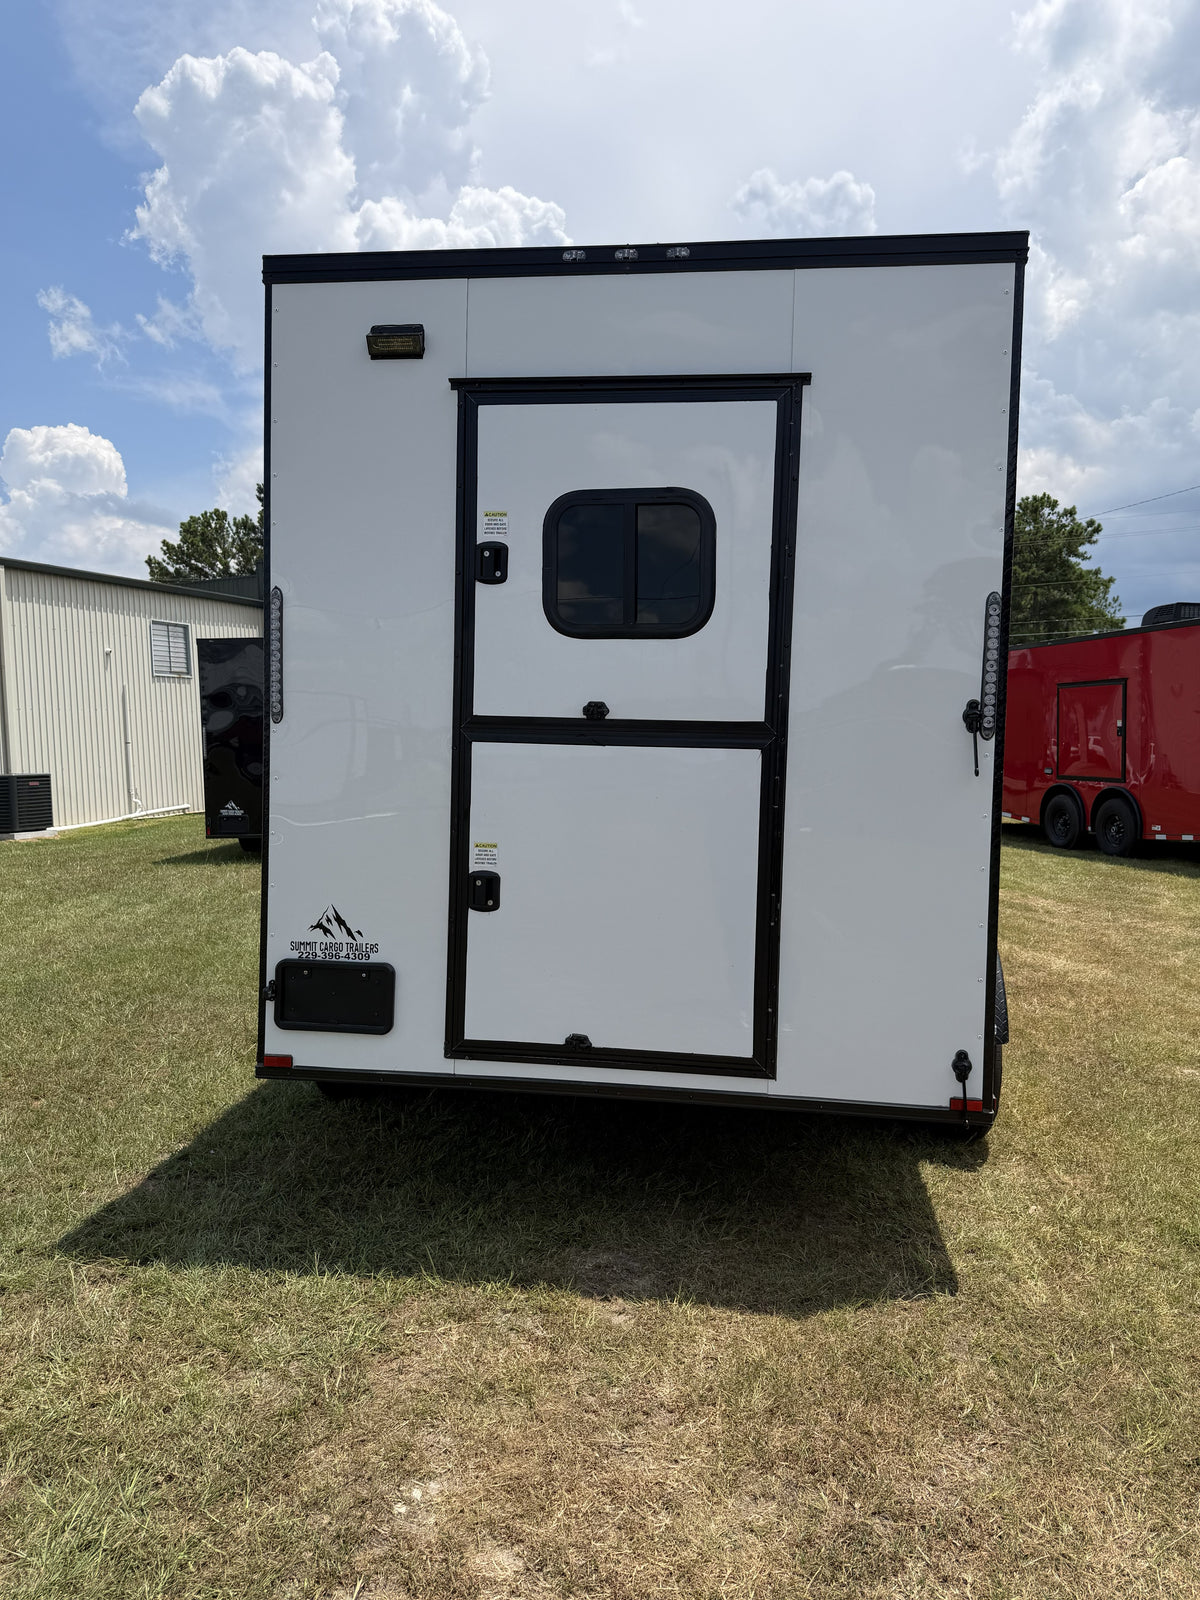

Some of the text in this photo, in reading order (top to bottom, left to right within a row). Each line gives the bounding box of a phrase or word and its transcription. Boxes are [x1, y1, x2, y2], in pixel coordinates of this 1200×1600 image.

[290, 941, 379, 954] SUMMIT CARGO TRAILERS
[298, 951, 370, 960] 229-396-4309
